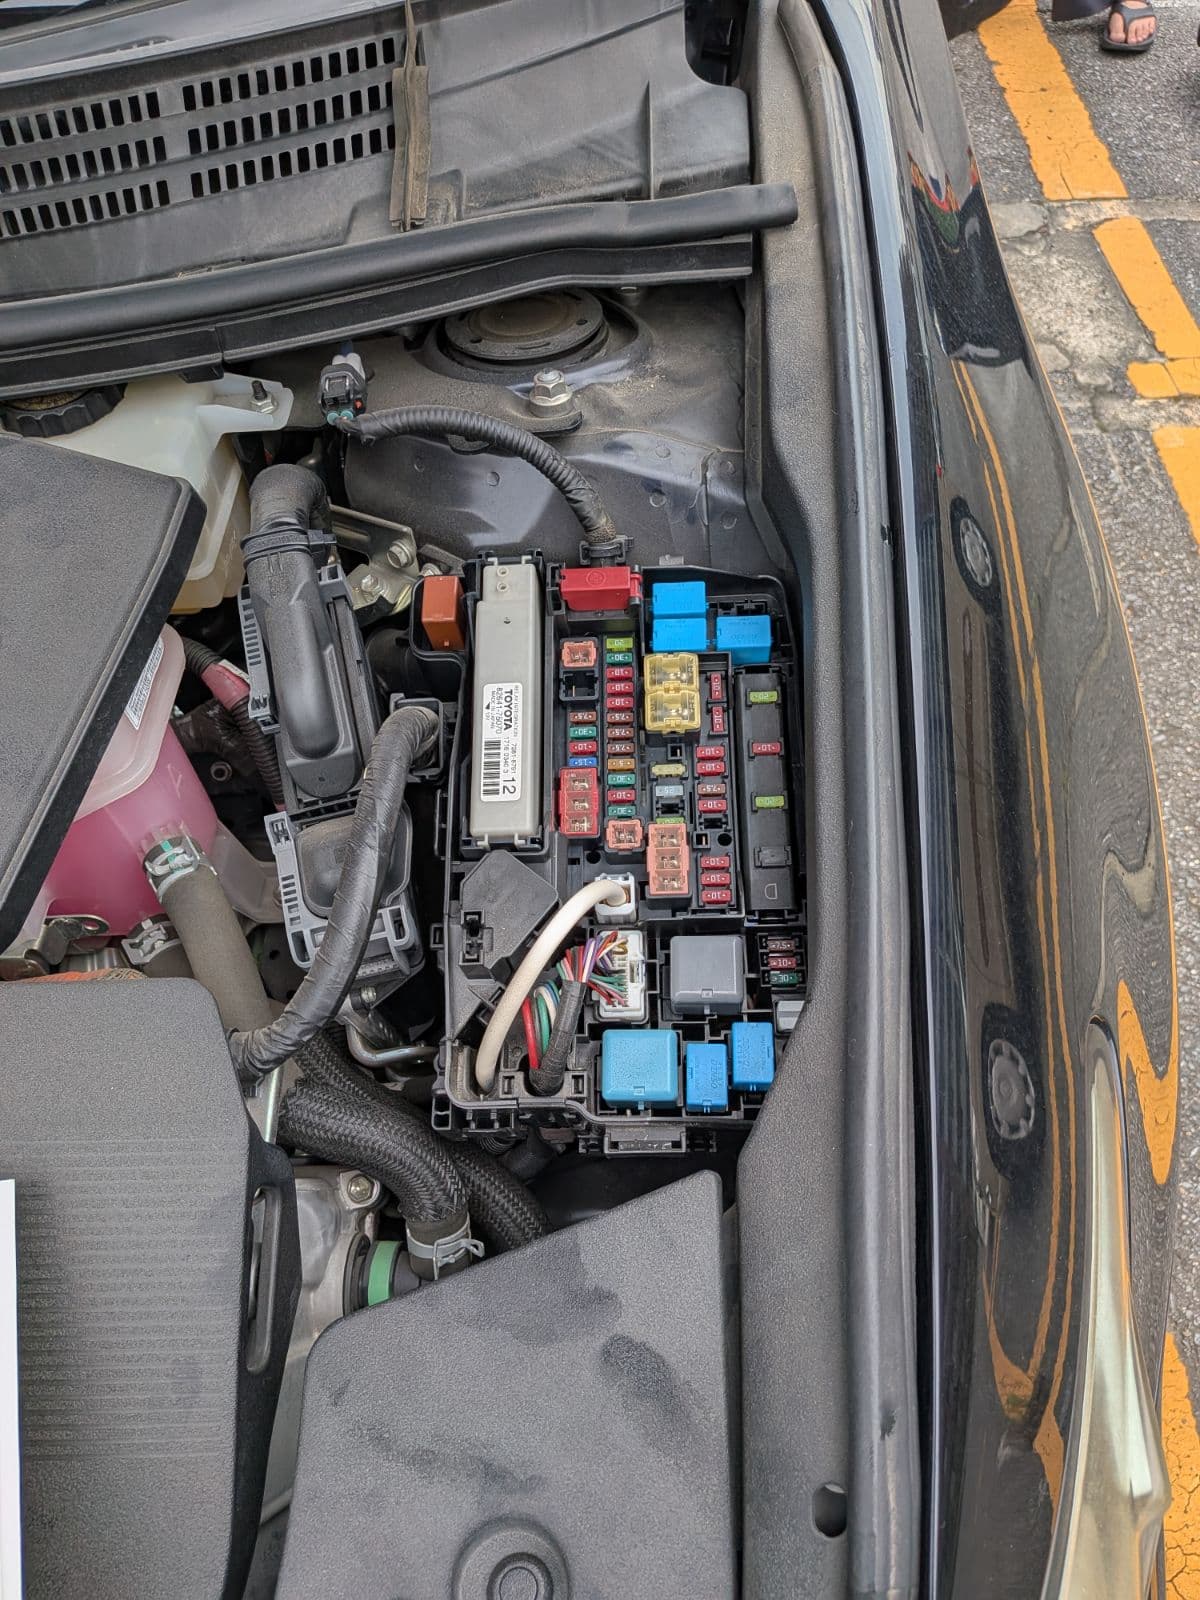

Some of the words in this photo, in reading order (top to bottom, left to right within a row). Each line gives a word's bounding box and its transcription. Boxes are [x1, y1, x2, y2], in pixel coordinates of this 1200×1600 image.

[503, 689, 513, 731] TOYOTA
[502, 777, 517, 795] 12
[778, 974, 789, 982] 30
